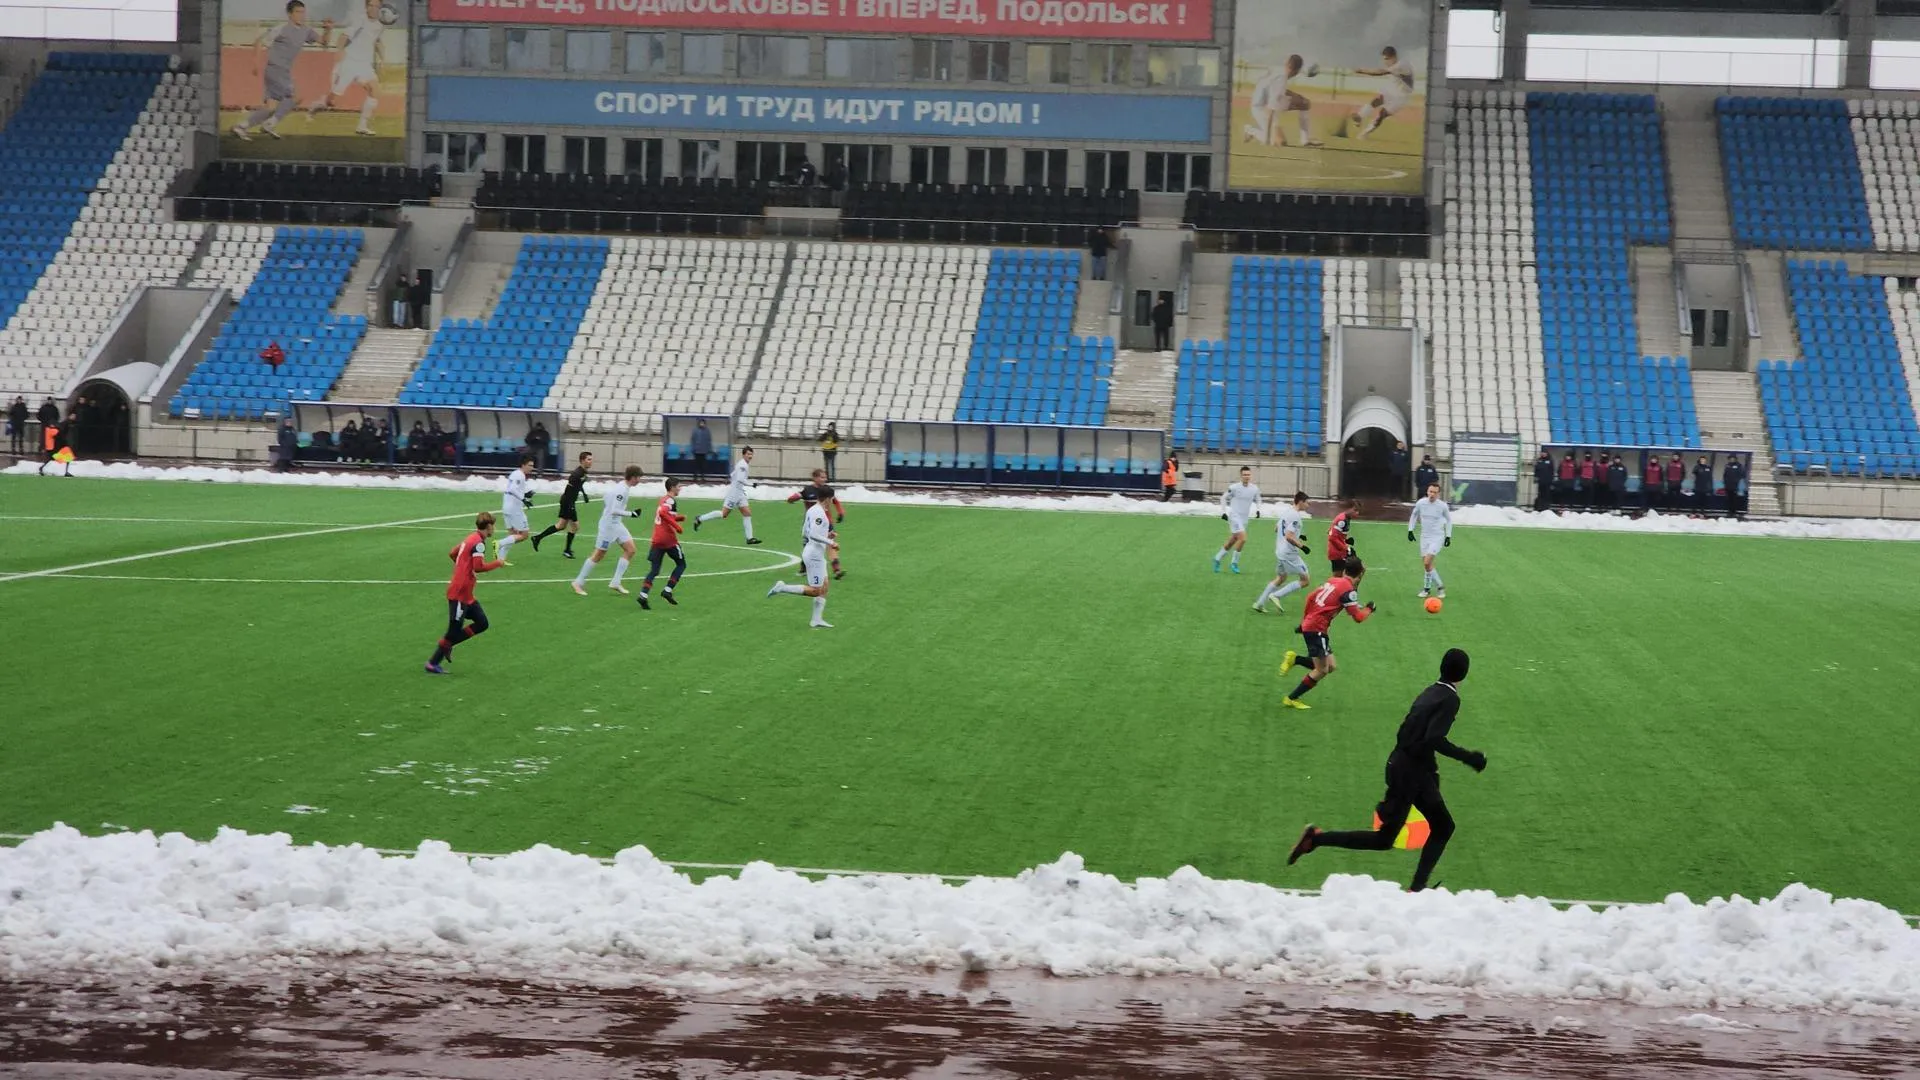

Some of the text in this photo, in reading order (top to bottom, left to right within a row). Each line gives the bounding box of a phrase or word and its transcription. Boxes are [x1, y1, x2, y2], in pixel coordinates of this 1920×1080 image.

[857, 0, 987, 24] ВПЕРЕД,
[997, 1, 1169, 26] ПОДОЛЬСК
[594, 91, 697, 115] СПОРТ
[706, 95, 727, 116] И
[736, 96, 815, 123] ТРУД
[824, 98, 905, 124] ИДУТ
[914, 100, 1022, 127] РЯДОМ
[813, 575, 819, 585] 3
